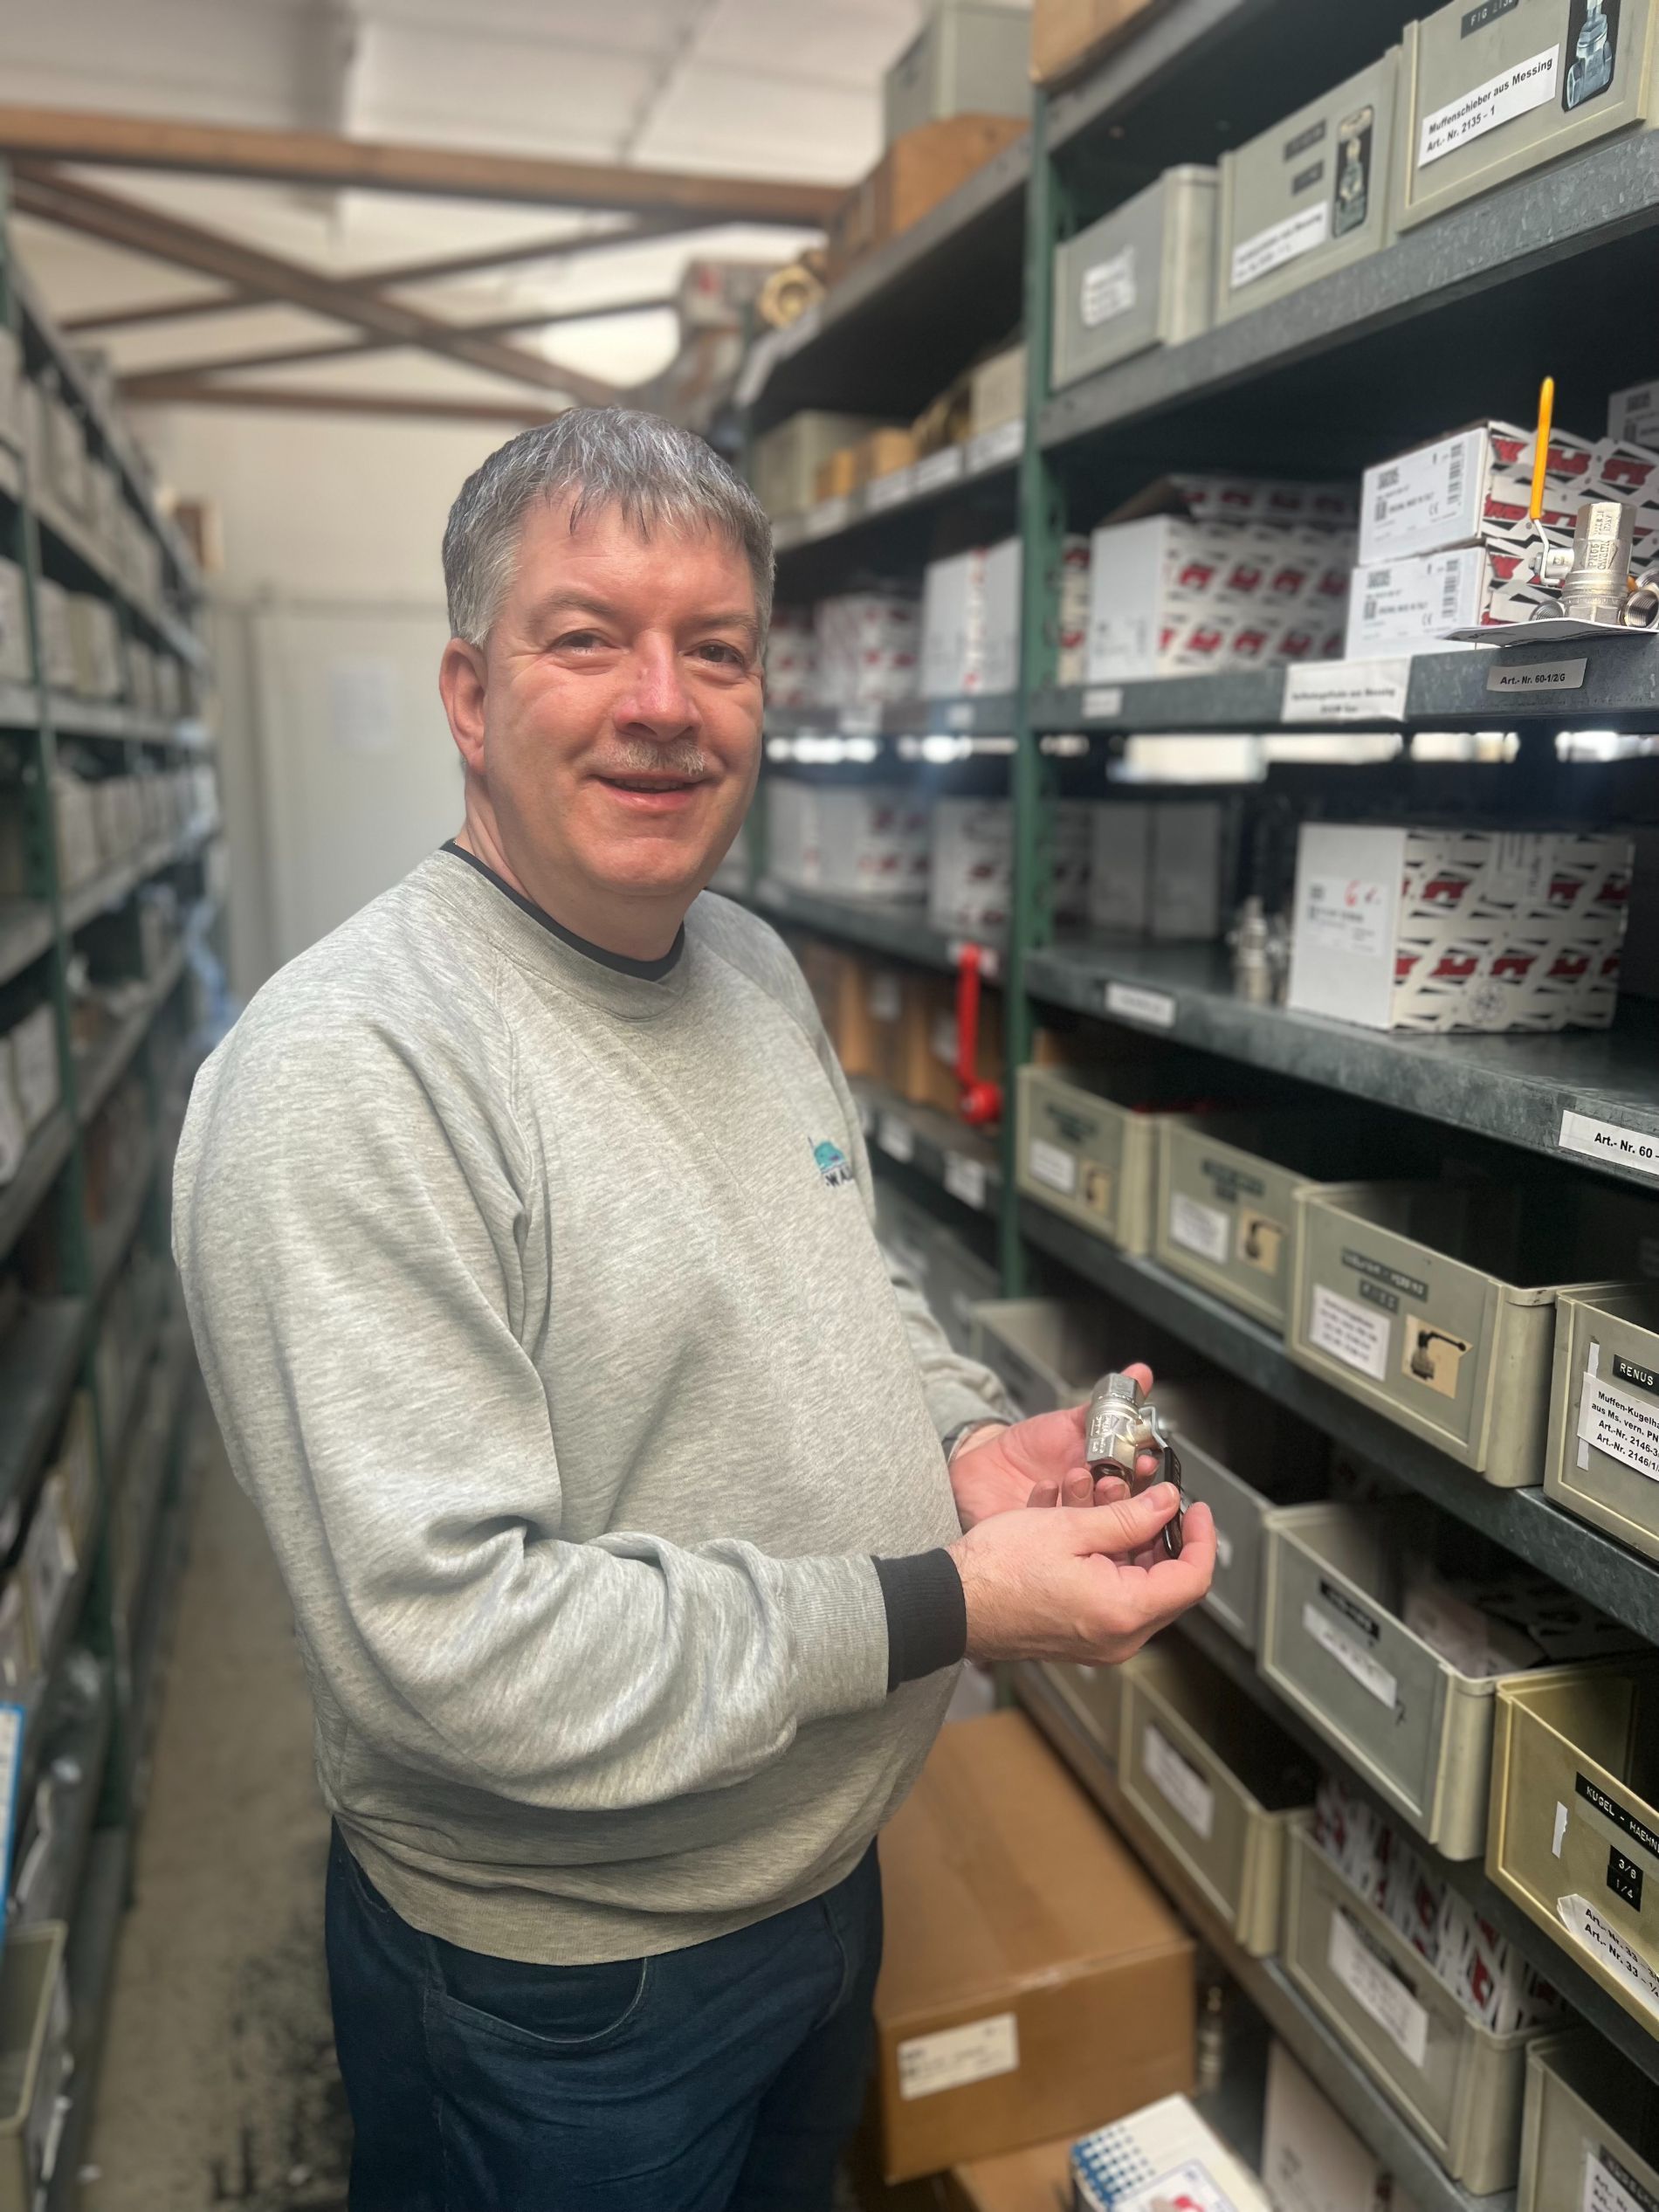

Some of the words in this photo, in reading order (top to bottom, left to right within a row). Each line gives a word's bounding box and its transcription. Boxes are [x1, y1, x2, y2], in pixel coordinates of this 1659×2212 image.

[1470, 9, 1487, 26] FIG
[1428, 91, 1491, 134] Muffenschieber
[1494, 81, 1509, 96] aus
[1512, 58, 1553, 86] Messing
[1447, 130, 1459, 141] Nr.
[1462, 114, 1481, 133] 2135
[1490, 105, 1495, 114] 1
[1521, 675, 1532, 685] Nr.
[1594, 1133, 1617, 1147] Art.-
[1621, 1140, 1635, 1154] Nr.
[1639, 1146, 1653, 1158] 60
[1620, 1362, 1654, 1386] RENUS
[1591, 1402, 1606, 1416] aus
[1607, 1409, 1621, 1423] Ms.
[1624, 1419, 1644, 1436] vern.
[1647, 1430, 1659, 1443] PN
[1596, 1433, 1626, 1454] Art.-Nr.
[1599, 1420, 1628, 1441] Art.-Nr.
[1630, 1436, 1659, 1457] 2146-3
[1587, 1786, 1615, 1816] KUGEL
[1630, 1821, 1659, 1853] HAEHN
[1618, 1859, 1636, 1879] 3/8
[1616, 1879, 1634, 1898] 1/4
[1585, 1924, 1606, 1946] Art.-
[1608, 1944, 1623, 1964] Nr.
[1626, 1960, 1638, 1977] 33
[1608, 1930, 1623, 1948] Nr.
[1626, 1947, 1638, 1962] 33
